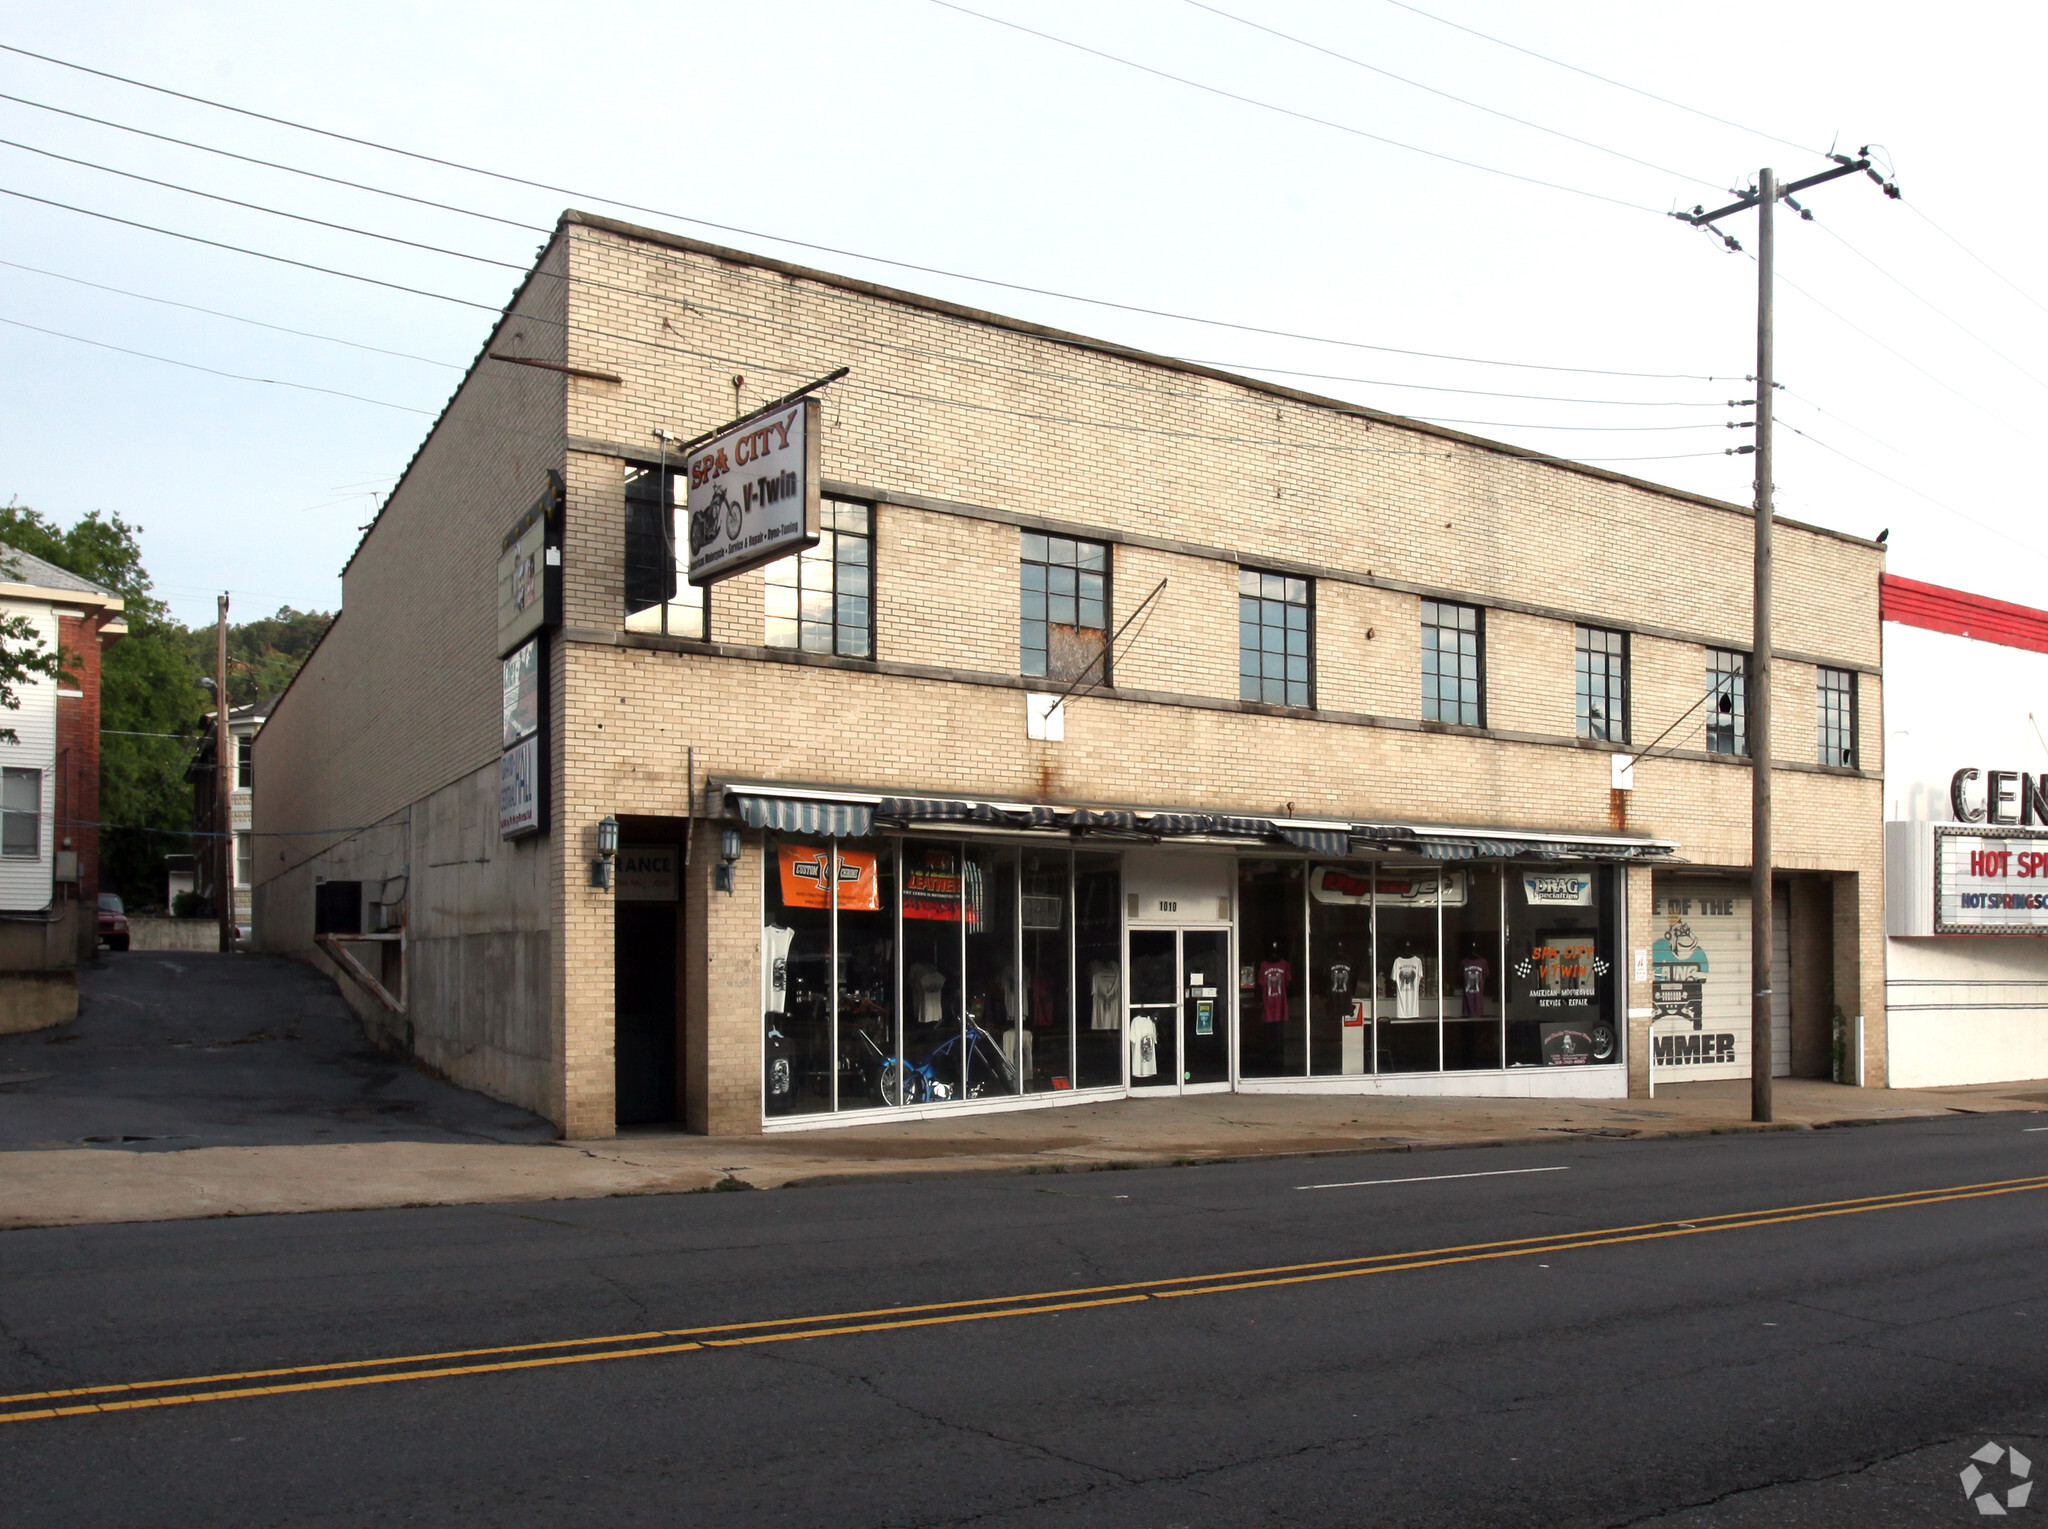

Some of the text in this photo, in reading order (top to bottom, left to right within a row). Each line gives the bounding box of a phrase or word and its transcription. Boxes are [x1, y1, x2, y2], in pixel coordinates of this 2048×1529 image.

[691, 409, 798, 490] SPA CITY
[743, 469, 797, 512] V-Twin
[728, 540, 744, 554] Service
[749, 532, 764, 547] Repair
[795, 864, 819, 876] CUSTOM
[1970, 850, 2012, 878] HOT
[1534, 876, 1580, 895] DRAG
[1159, 900, 1177, 912] 1010
[1668, 898, 1692, 916] OF
[1698, 898, 1733, 916] THE
[1531, 945, 1595, 960] SPA CITY
[1529, 989, 1558, 997] AMERICAN
[1539, 998, 1589, 1007] SERVICE REPAIR
[1653, 1033, 1735, 1066] MMER
